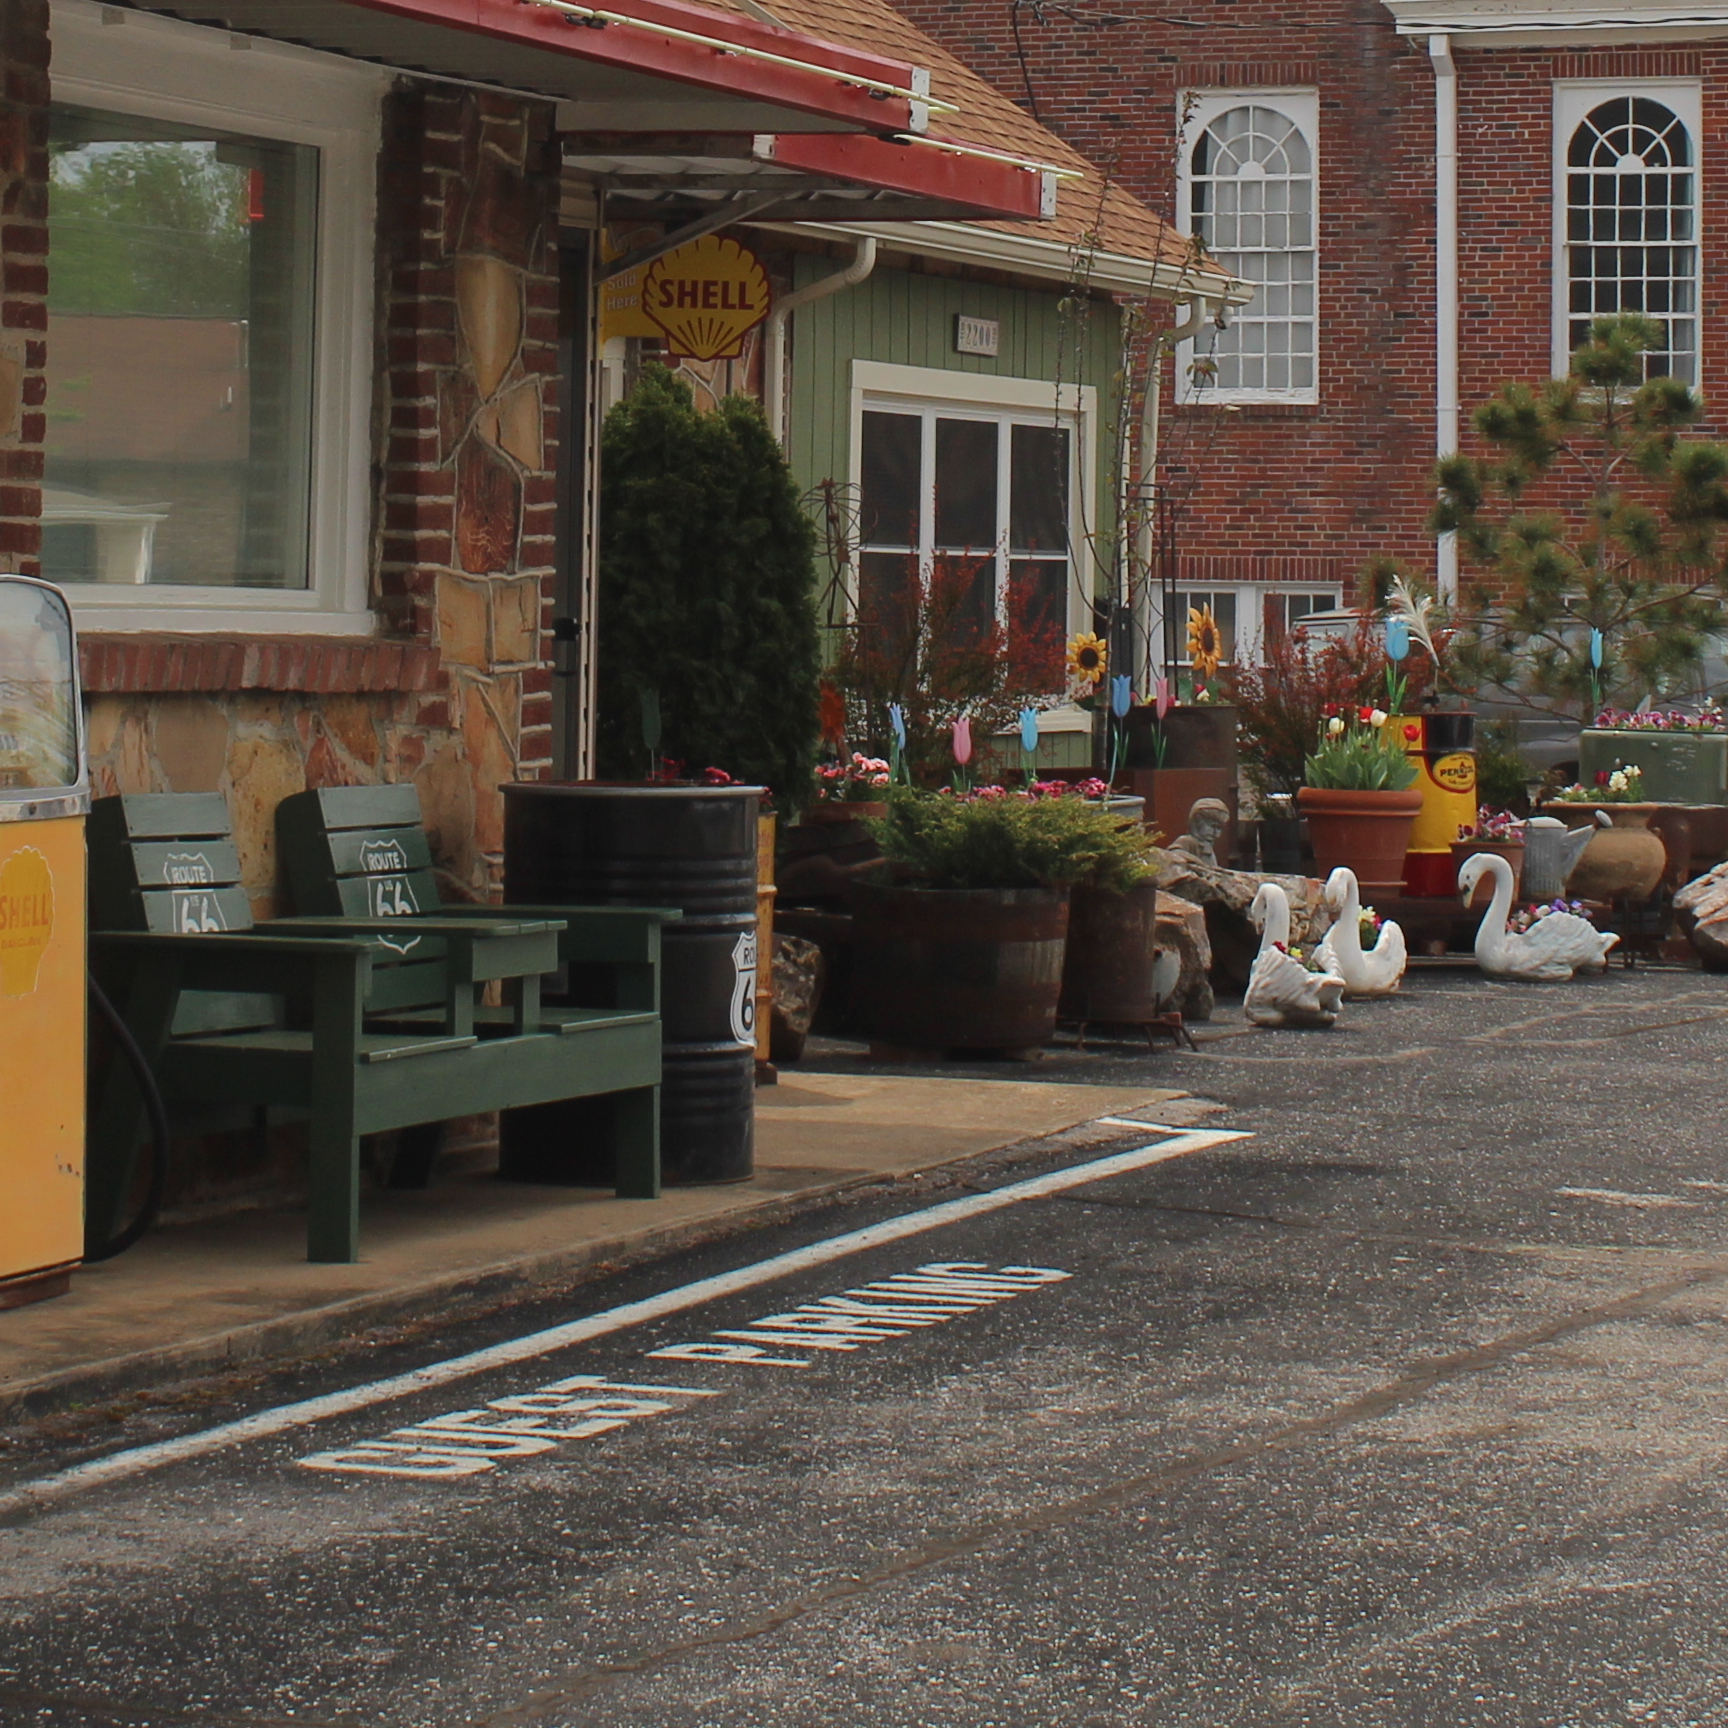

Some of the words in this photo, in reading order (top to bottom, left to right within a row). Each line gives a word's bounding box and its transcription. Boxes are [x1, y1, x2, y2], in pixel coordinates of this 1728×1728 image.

[607, 272, 638, 292] Sold
[606, 293, 638, 312] Here
[658, 278, 755, 311] SHELL
[367, 852, 401, 870] ROUTE
[171, 865, 207, 883] ROUTE
[295, 1373, 724, 1477] GUEST
[644, 1261, 1074, 1368] PARKING
